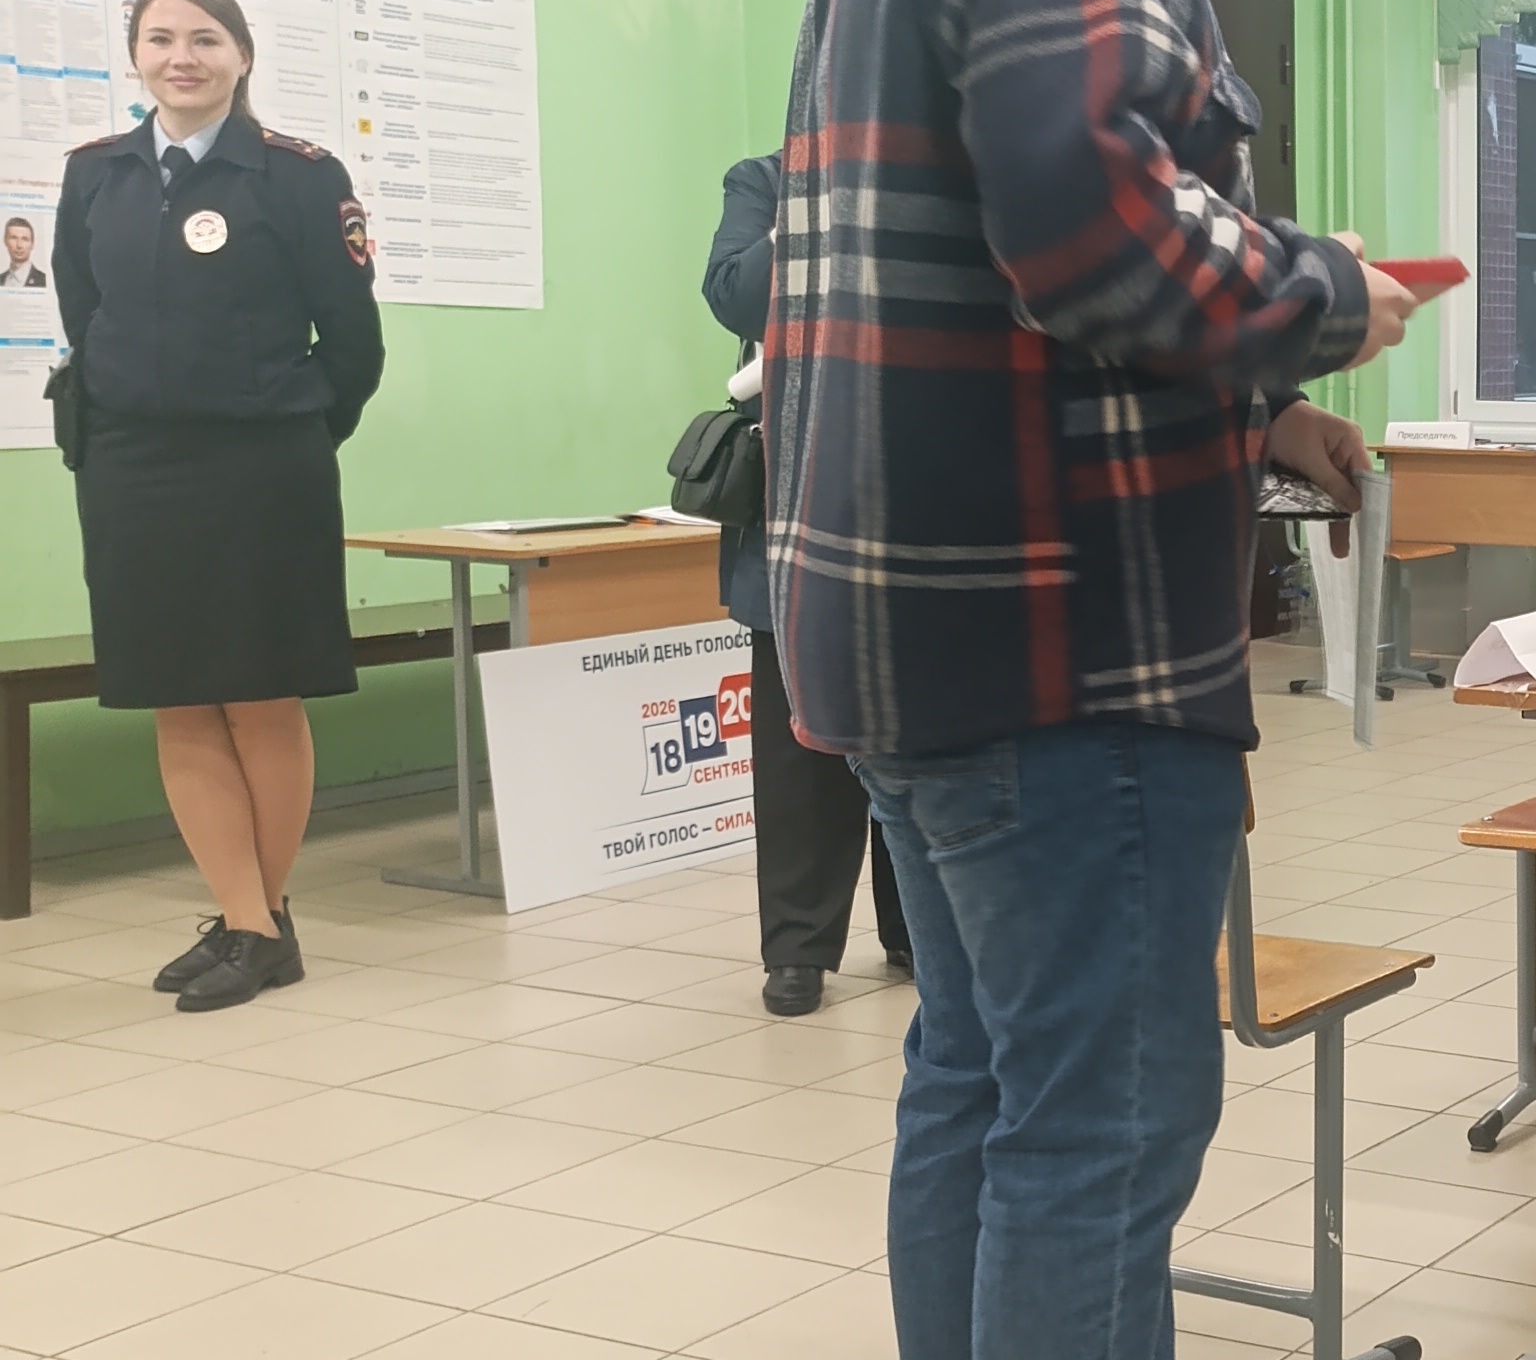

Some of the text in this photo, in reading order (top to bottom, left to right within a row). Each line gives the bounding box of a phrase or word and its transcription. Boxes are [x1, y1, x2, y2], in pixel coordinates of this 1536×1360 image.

[1397, 431, 1458, 440] Председатель
[582, 643, 650, 673] ЕДИНЫЙ
[653, 641, 692, 663] ДЕНЬ
[641, 699, 677, 719] 2026
[650, 687, 751, 776] 18 19 20
[603, 831, 646, 859] ТВОЙ
[649, 823, 699, 849] ГОЛОС
[715, 811, 754, 832] СИЛА
